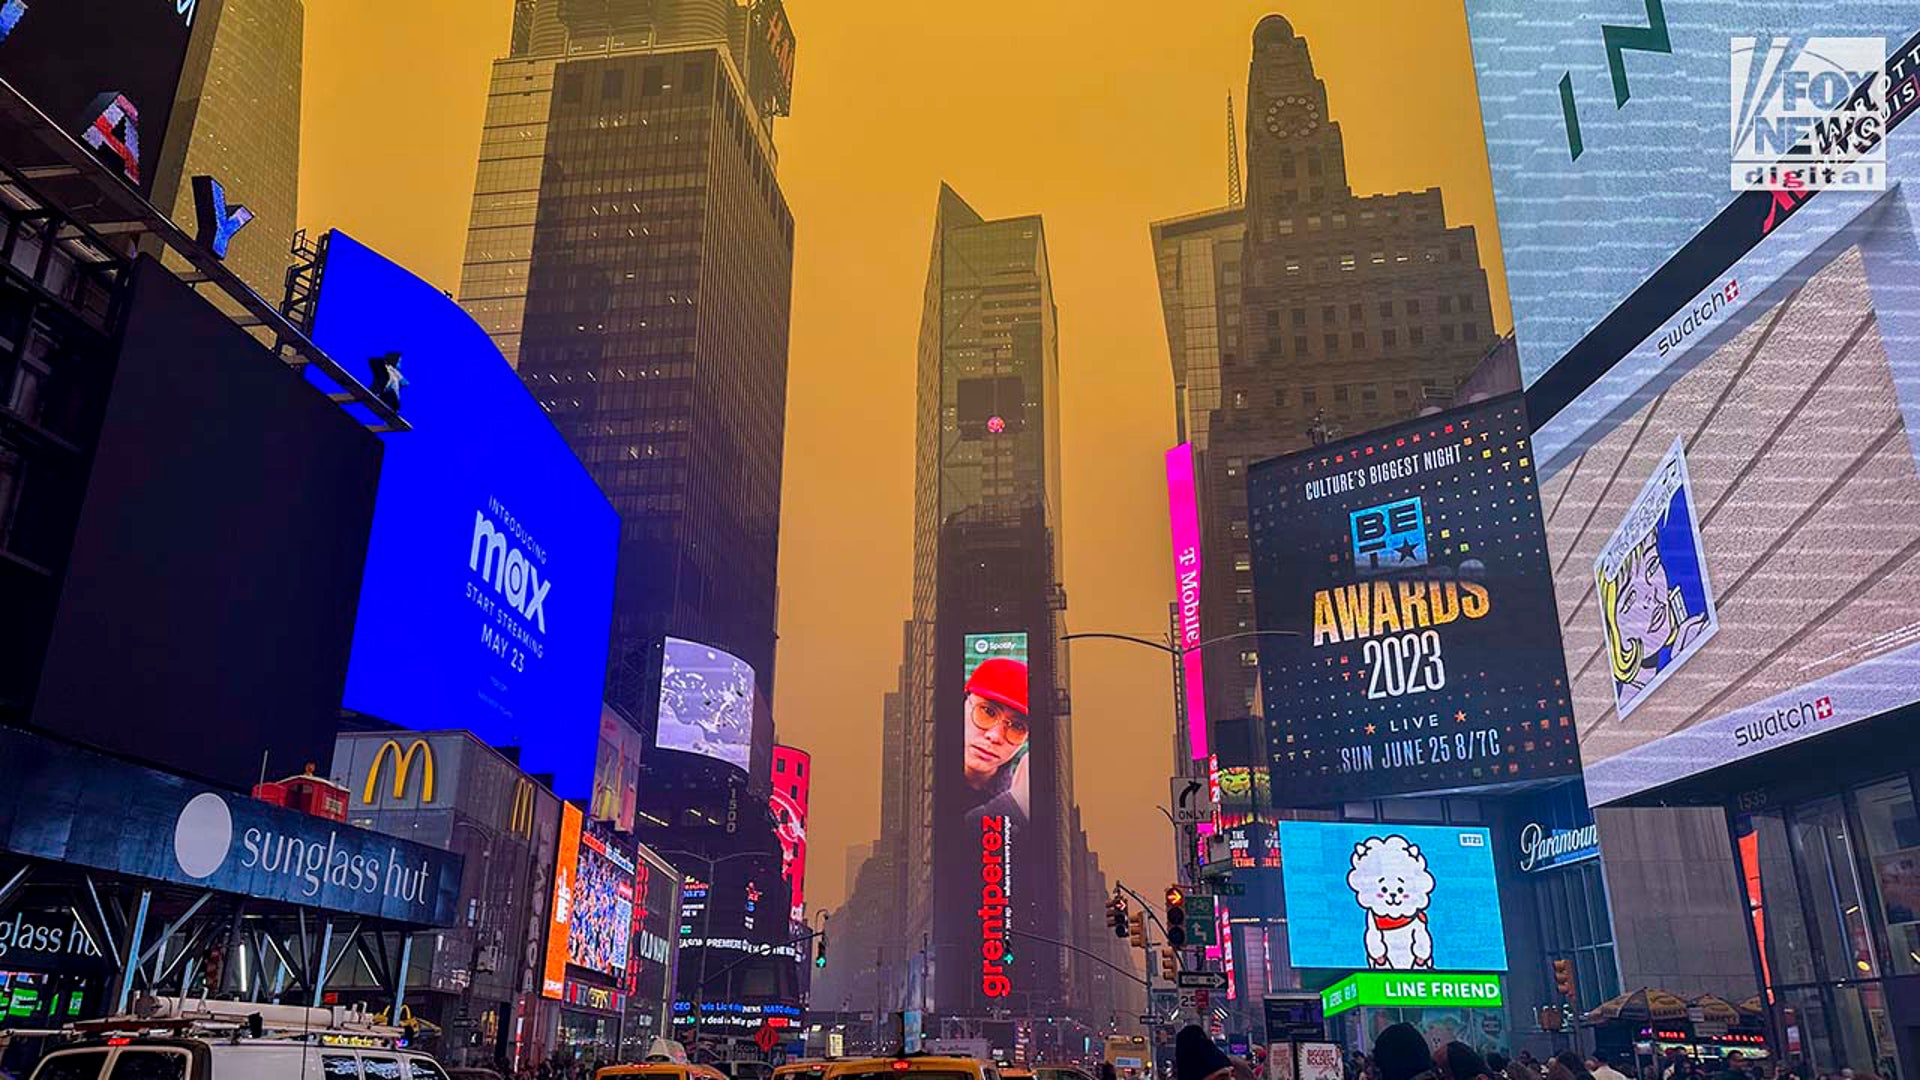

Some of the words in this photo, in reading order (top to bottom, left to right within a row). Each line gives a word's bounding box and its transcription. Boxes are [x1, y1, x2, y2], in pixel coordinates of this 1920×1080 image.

[1657, 290, 1727, 357] swatch
[1305, 469, 1366, 502] CULTURE'S
[1369, 455, 1422, 486] BIGGEST
[1424, 445, 1462, 475] NIGHT
[488, 494, 548, 565] INTRODUCING
[469, 509, 552, 635] max
[465, 581, 495, 617] START
[496, 608, 544, 660] STREAMING
[1181, 569, 1202, 646] Mobile
[1312, 577, 1491, 647] AWARDS
[480, 623, 509, 659] MAY
[511, 648, 525, 673] 23
[1362, 629, 1446, 700] 2023
[1341, 744, 1375, 774] SUN
[1381, 738, 1425, 769] JUNE
[1428, 736, 1450, 760] 25
[1454, 728, 1501, 759] 8/7C
[1389, 714, 1441, 733] LIVE
[1735, 700, 1815, 748] swatch
[1178, 809, 1206, 820] ONLY
[1520, 822, 1599, 872] Paramoun
[242, 826, 380, 897] sunglass
[388, 846, 430, 905] hut
[976, 816, 1012, 998] grentperez
[1385, 981, 1427, 998] LINE
[1431, 982, 1500, 999] FRIEND
